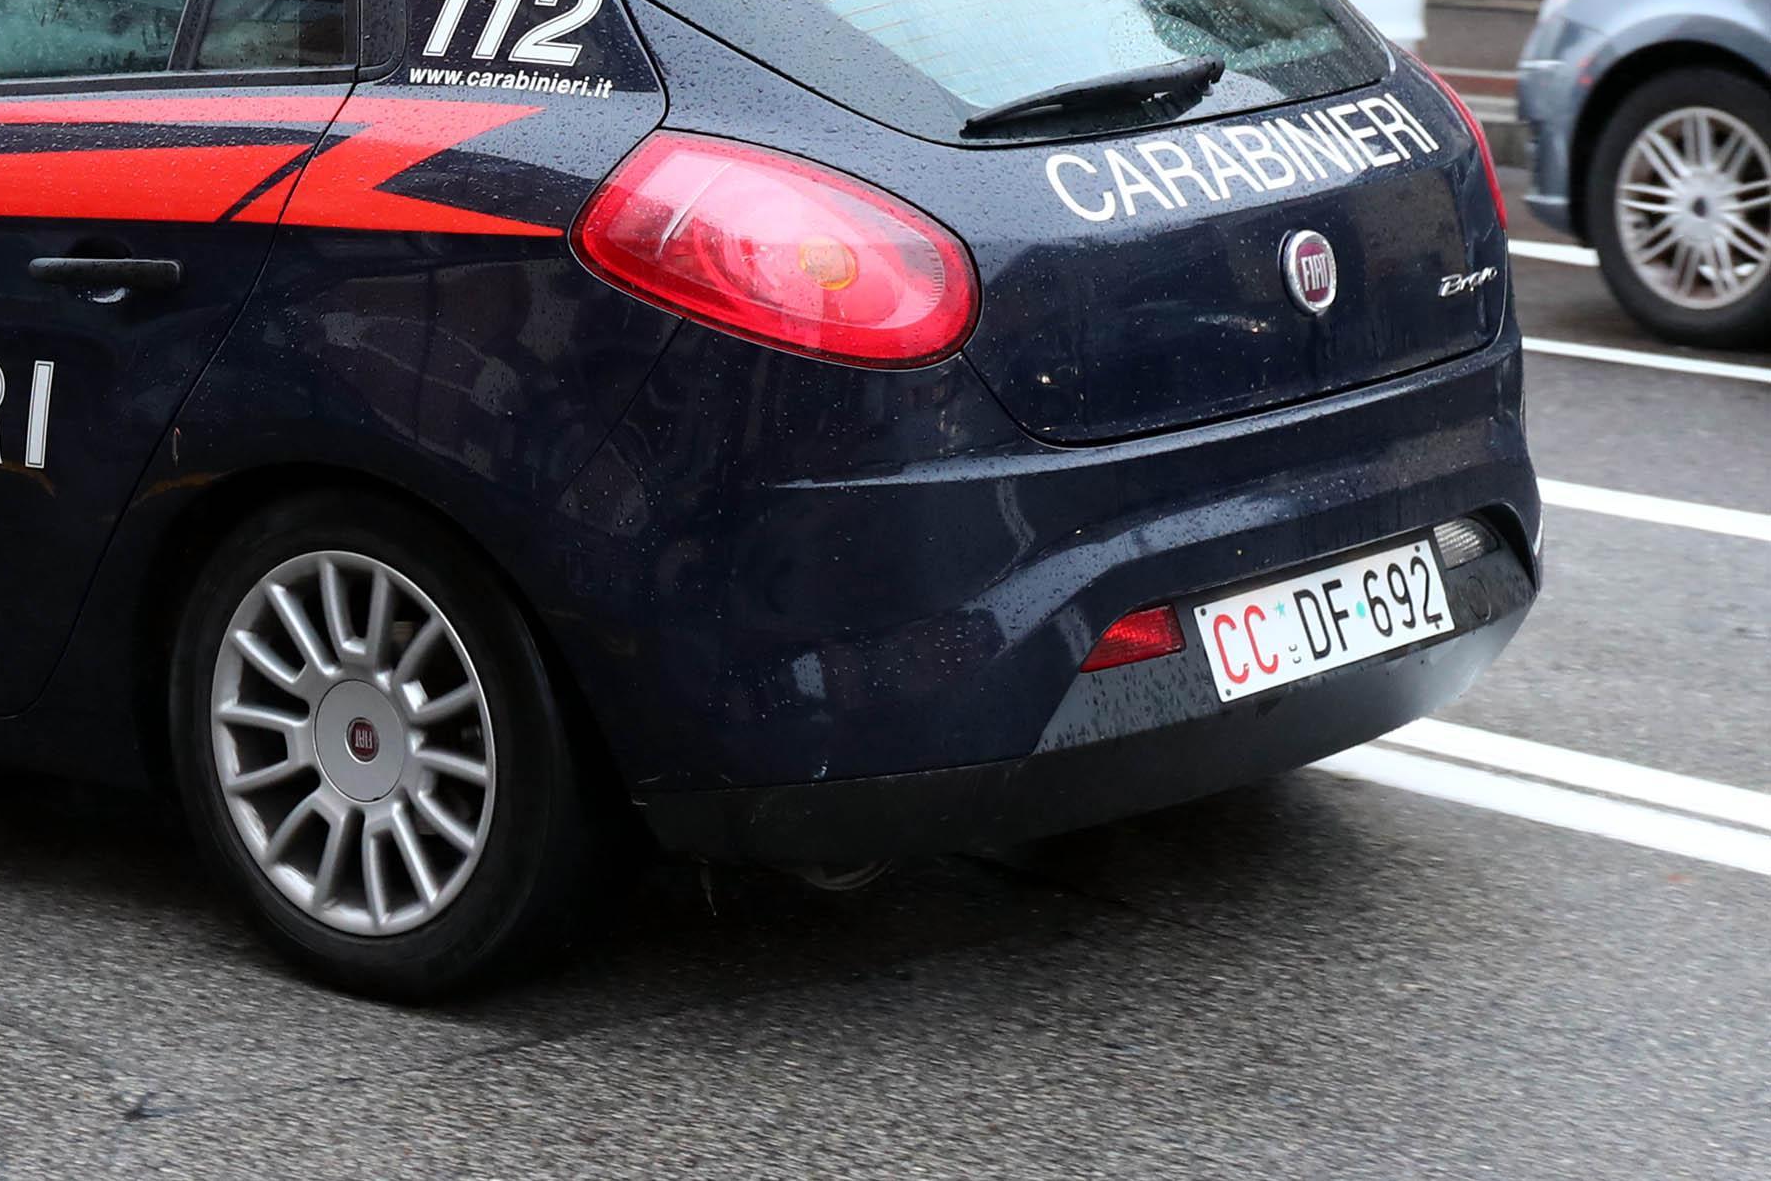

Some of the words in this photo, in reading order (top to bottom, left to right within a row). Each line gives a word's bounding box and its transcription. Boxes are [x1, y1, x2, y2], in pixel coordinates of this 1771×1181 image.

[409, 67, 613, 99] www.carabinieri.it
[1045, 93, 1439, 222] CARABINIERI
[1301, 253, 1329, 292] FIAT
[1213, 605, 1278, 684] CC
[1293, 579, 1350, 661] DF
[1363, 556, 1443, 637] 692
